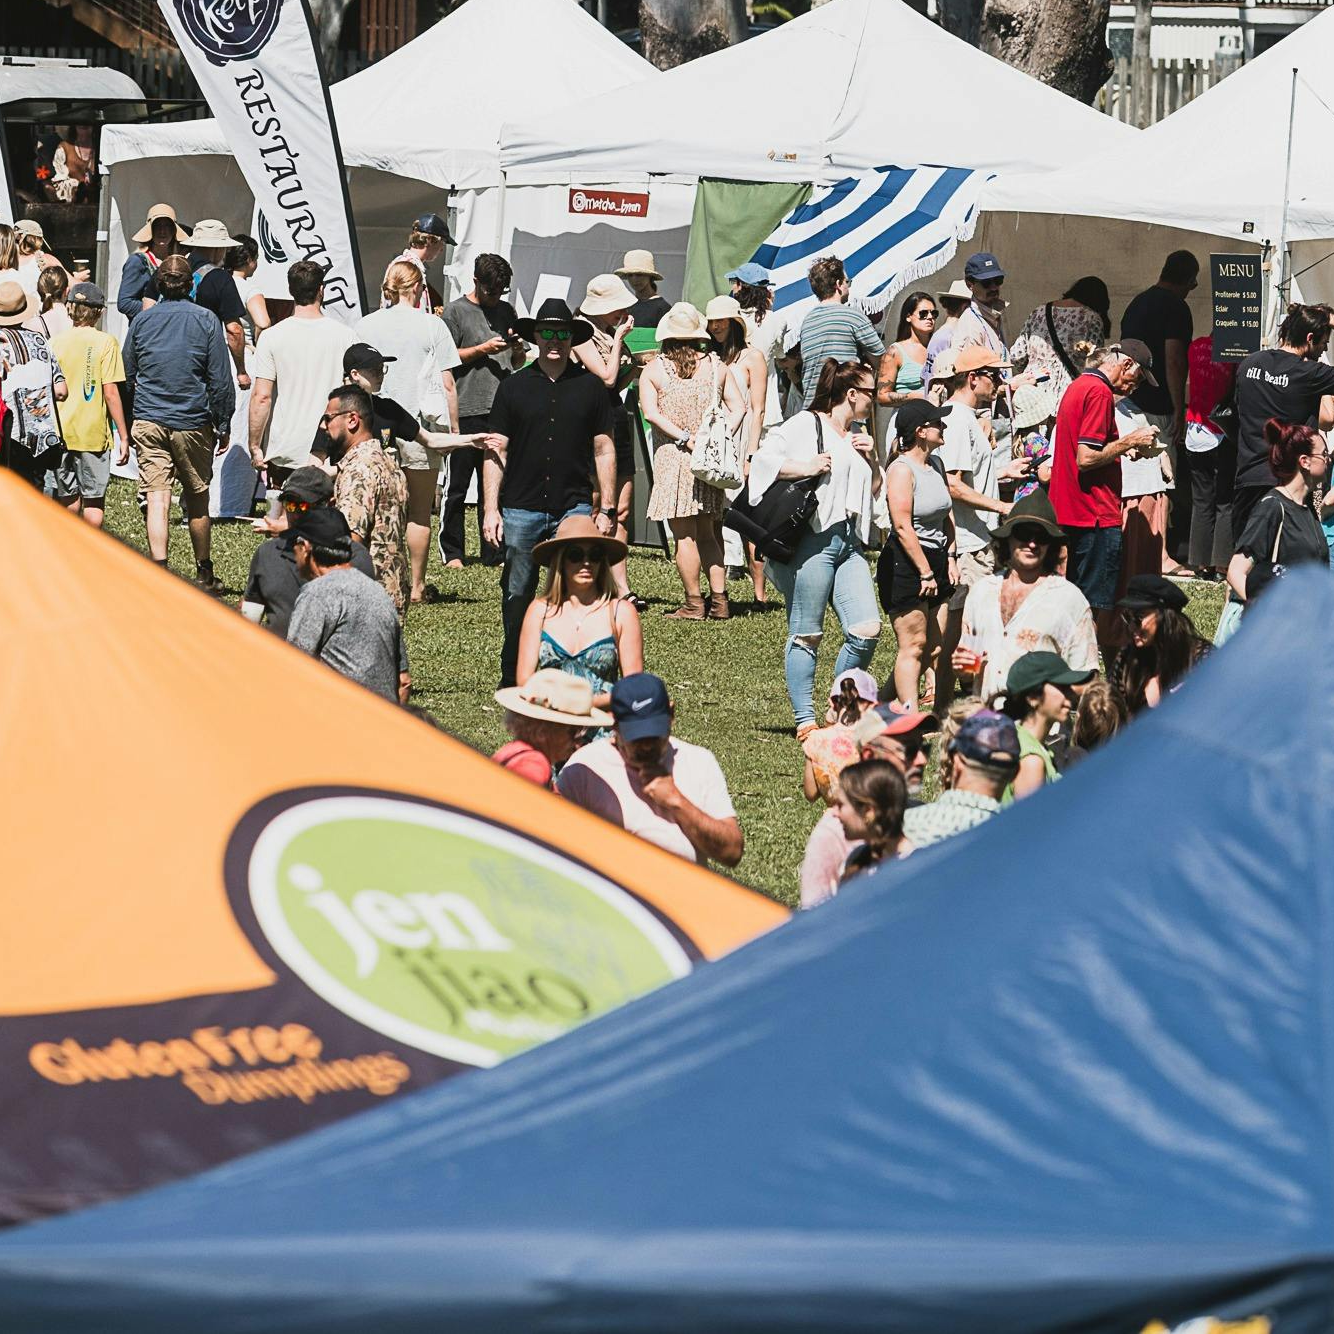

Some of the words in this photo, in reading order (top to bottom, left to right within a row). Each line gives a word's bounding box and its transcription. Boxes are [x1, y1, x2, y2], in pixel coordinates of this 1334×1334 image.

[1219, 264, 1254, 278] MENU
[1215, 291, 1240, 299] Profiterole
[1215, 305, 1229, 313] Eclair
[1215, 319, 1238, 328] Craquelin
[1246, 320, 1259, 328] 15.00
[1246, 367, 1262, 380] till
[287, 863, 514, 980] jen
[393, 946, 591, 1027] jiao
[182, 1051, 410, 1105] Dumplings
